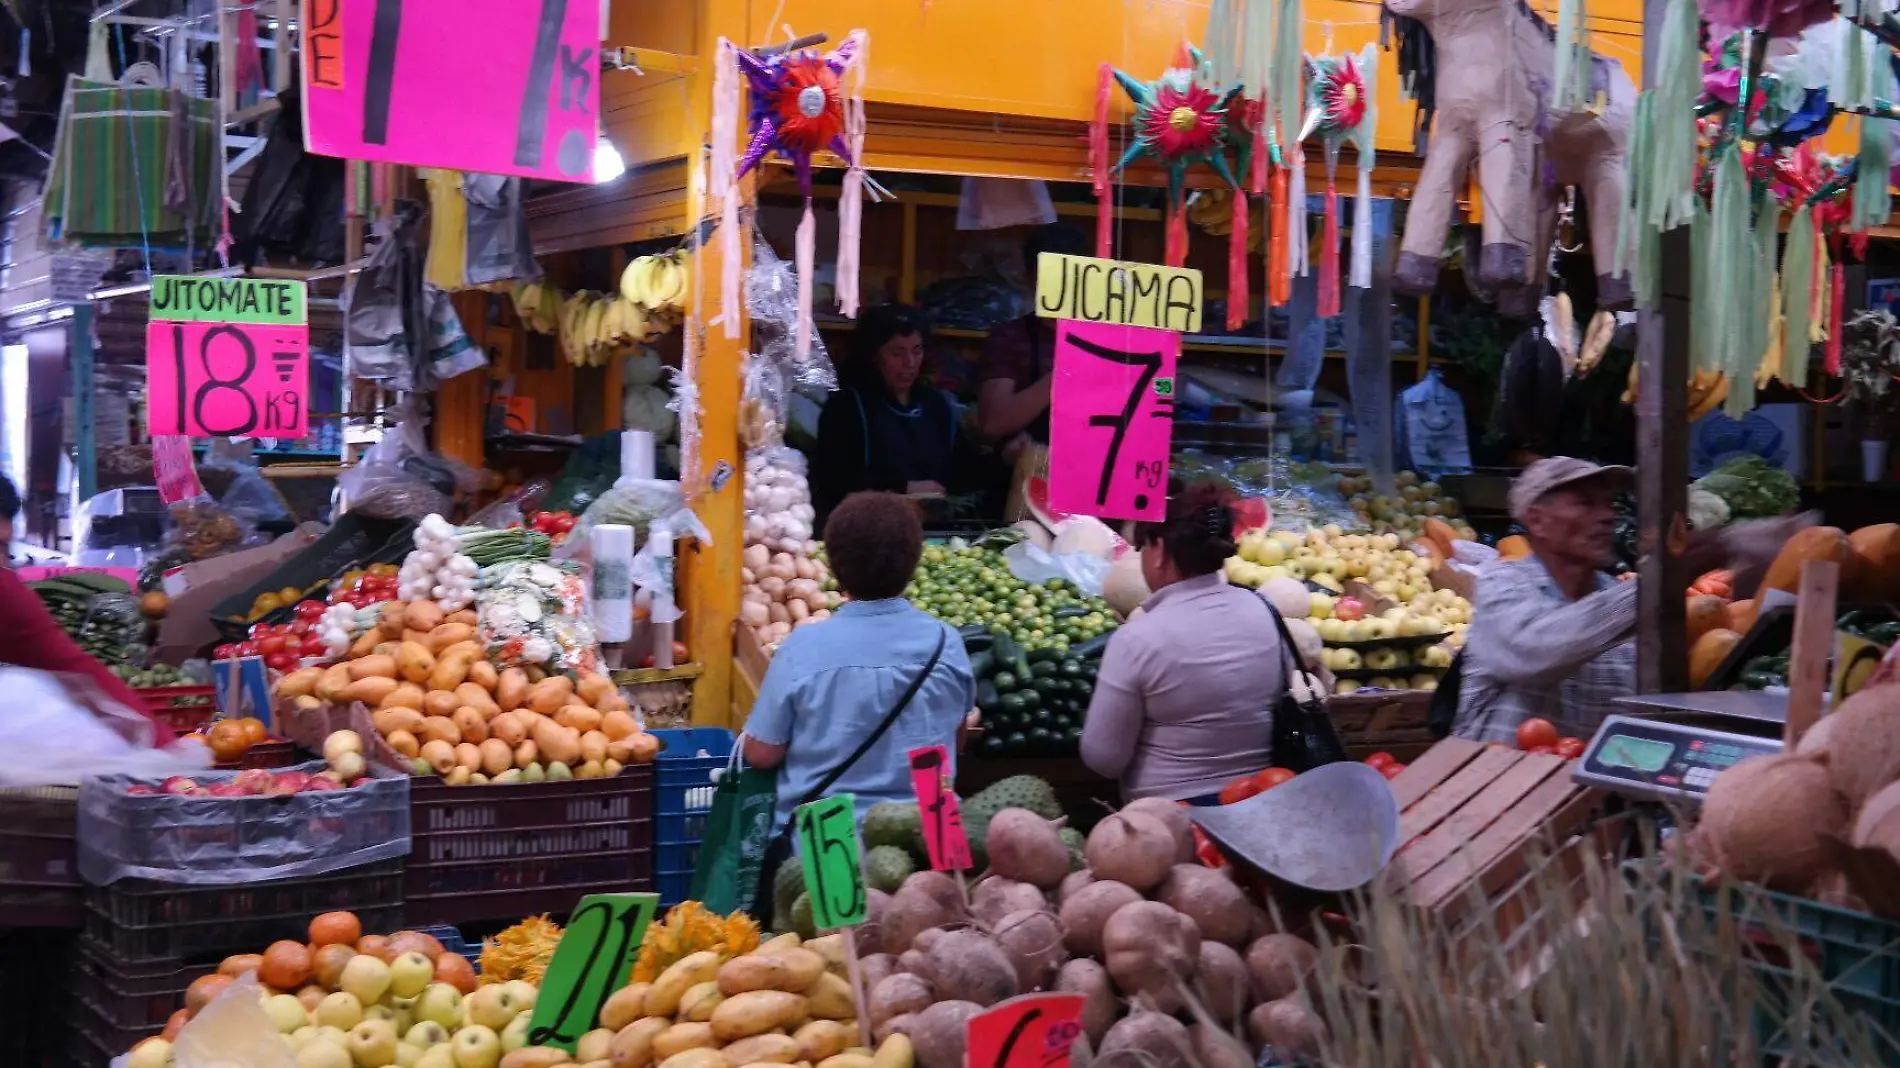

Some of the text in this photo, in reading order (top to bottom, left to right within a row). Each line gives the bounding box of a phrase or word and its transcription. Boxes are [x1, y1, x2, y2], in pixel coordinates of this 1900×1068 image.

[153, 279, 292, 315] JITOMATE
[1042, 258, 1195, 331] JICAMA
[173, 325, 258, 437] 18
[1065, 332, 1163, 506] 7
[801, 803, 858, 926] 15
[528, 902, 641, 1045] 21
